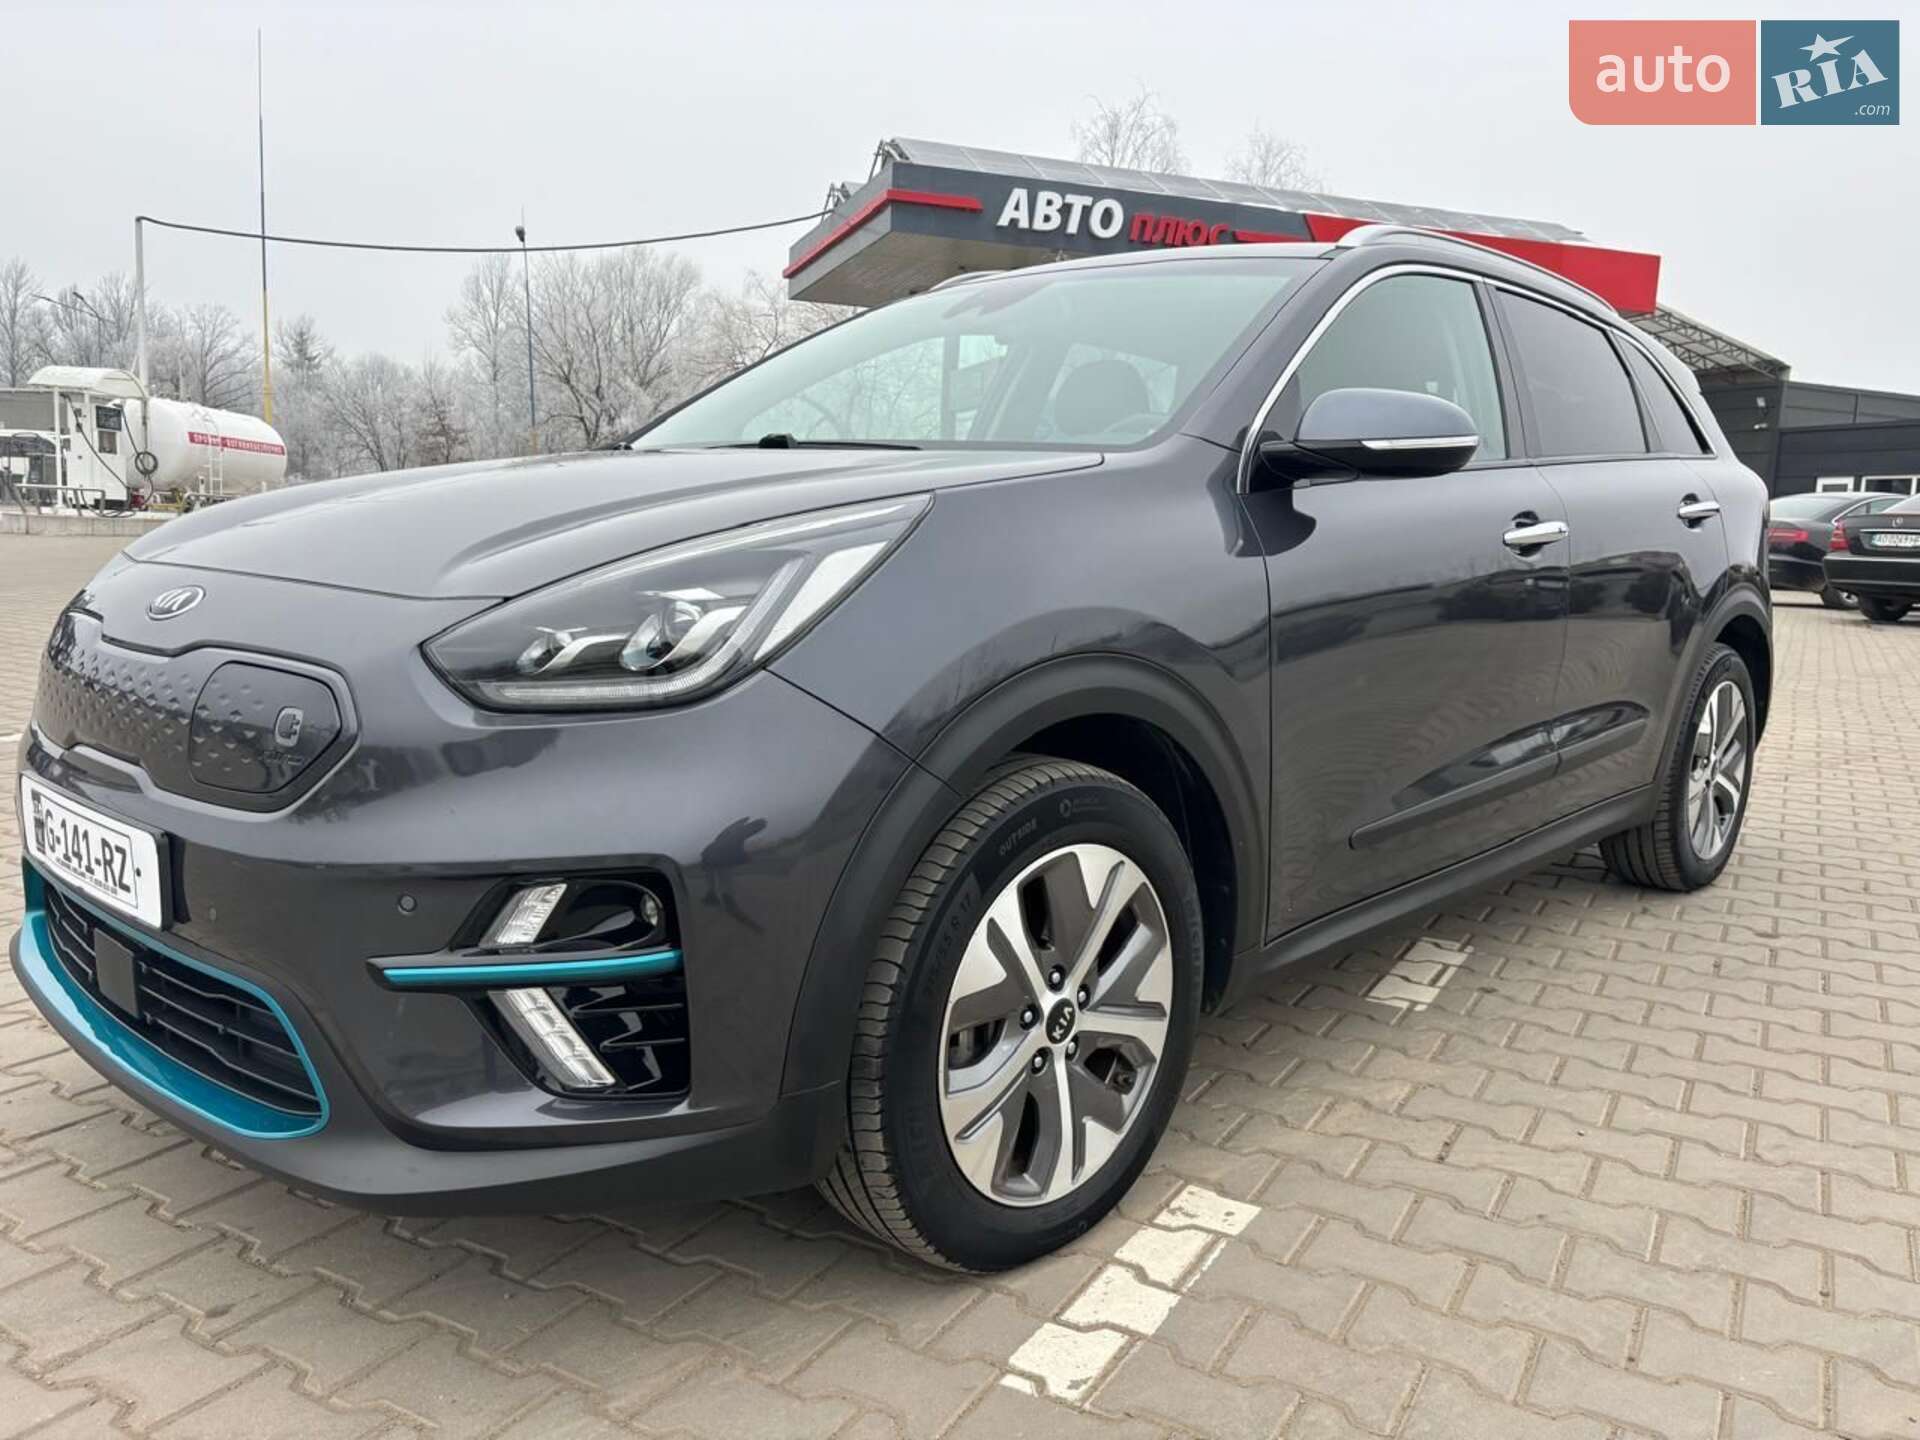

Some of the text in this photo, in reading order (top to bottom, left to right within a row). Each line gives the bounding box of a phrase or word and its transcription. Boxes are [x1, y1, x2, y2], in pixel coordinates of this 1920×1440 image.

[997, 187, 1124, 239] АВТО
[44, 809, 132, 894] G-141-RZ
[1051, 1006, 1074, 1041] KIA
